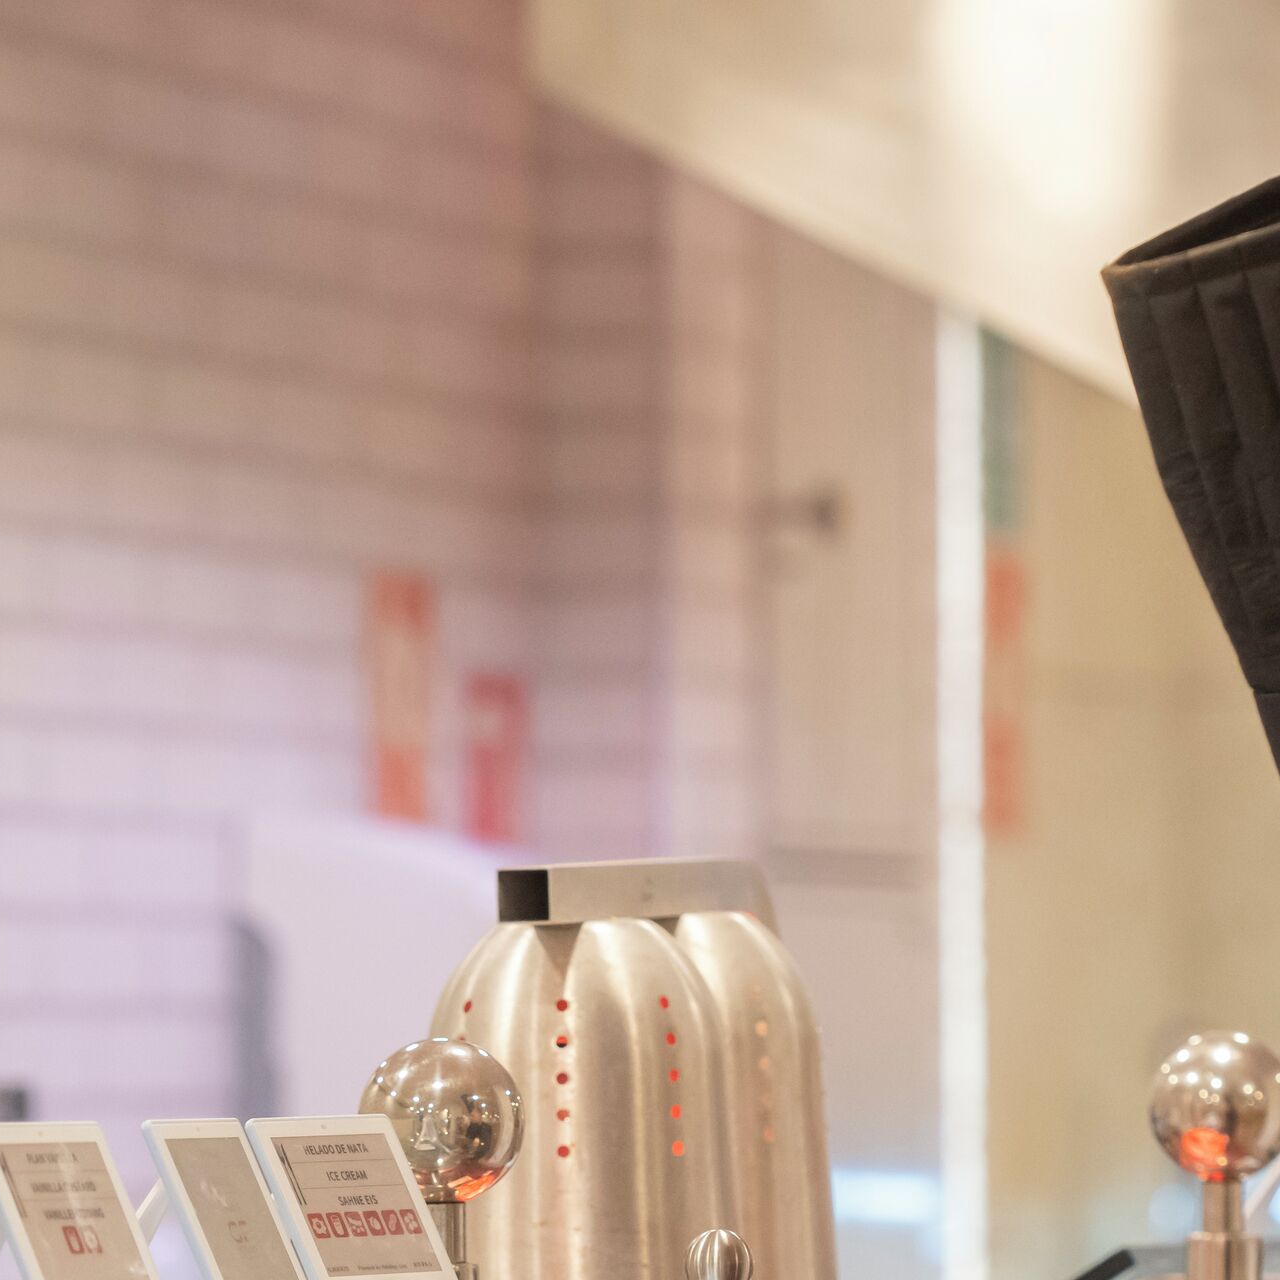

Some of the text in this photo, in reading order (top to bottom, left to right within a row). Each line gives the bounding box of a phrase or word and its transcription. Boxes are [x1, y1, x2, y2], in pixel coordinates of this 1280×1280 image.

[303, 1143, 369, 1156] HELADO DE NATA
[326, 1169, 368, 1182] ICE CREAM
[337, 1194, 379, 1207] SAHNE EIS
